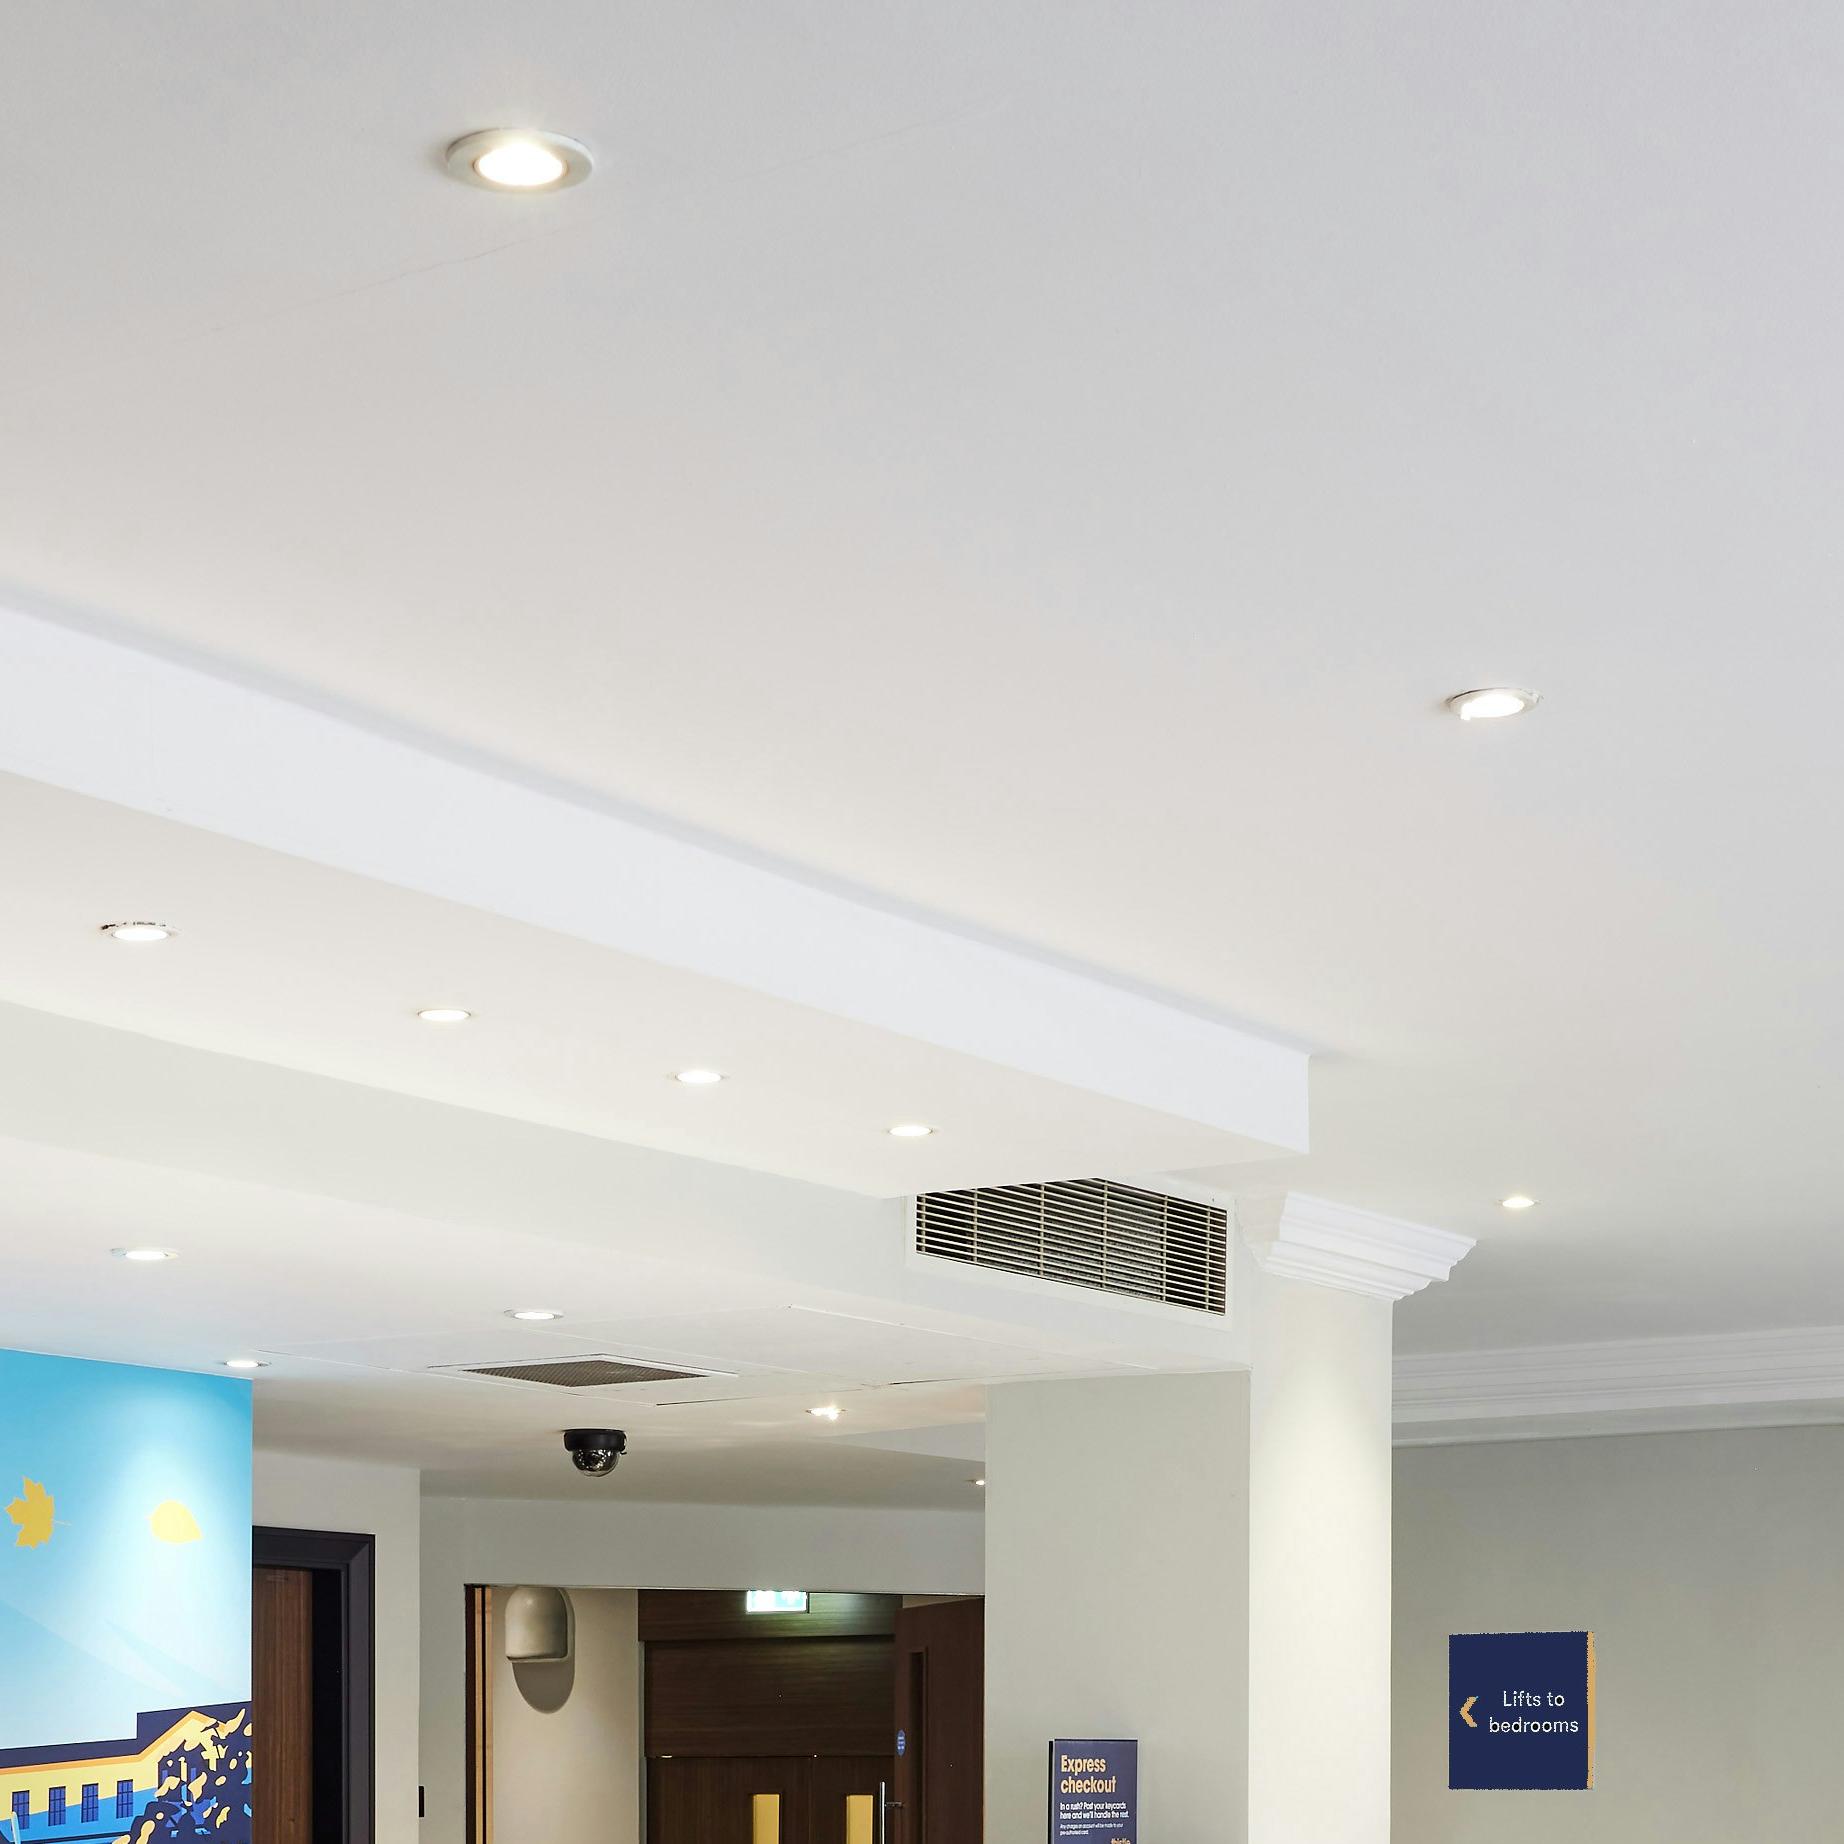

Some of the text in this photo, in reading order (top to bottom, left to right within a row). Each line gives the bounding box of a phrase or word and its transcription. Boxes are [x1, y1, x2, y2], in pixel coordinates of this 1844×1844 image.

[1503, 1690, 1565, 1706] Lifts to
[1489, 1716, 1579, 1733] bedrooms
[1061, 1754, 1106, 1776] Express
[1060, 1776, 1117, 1793] checkout
[1060, 1811, 1071, 1819] here
[1071, 1811, 1082, 1819] and
[1094, 1803, 1104, 1811] your
